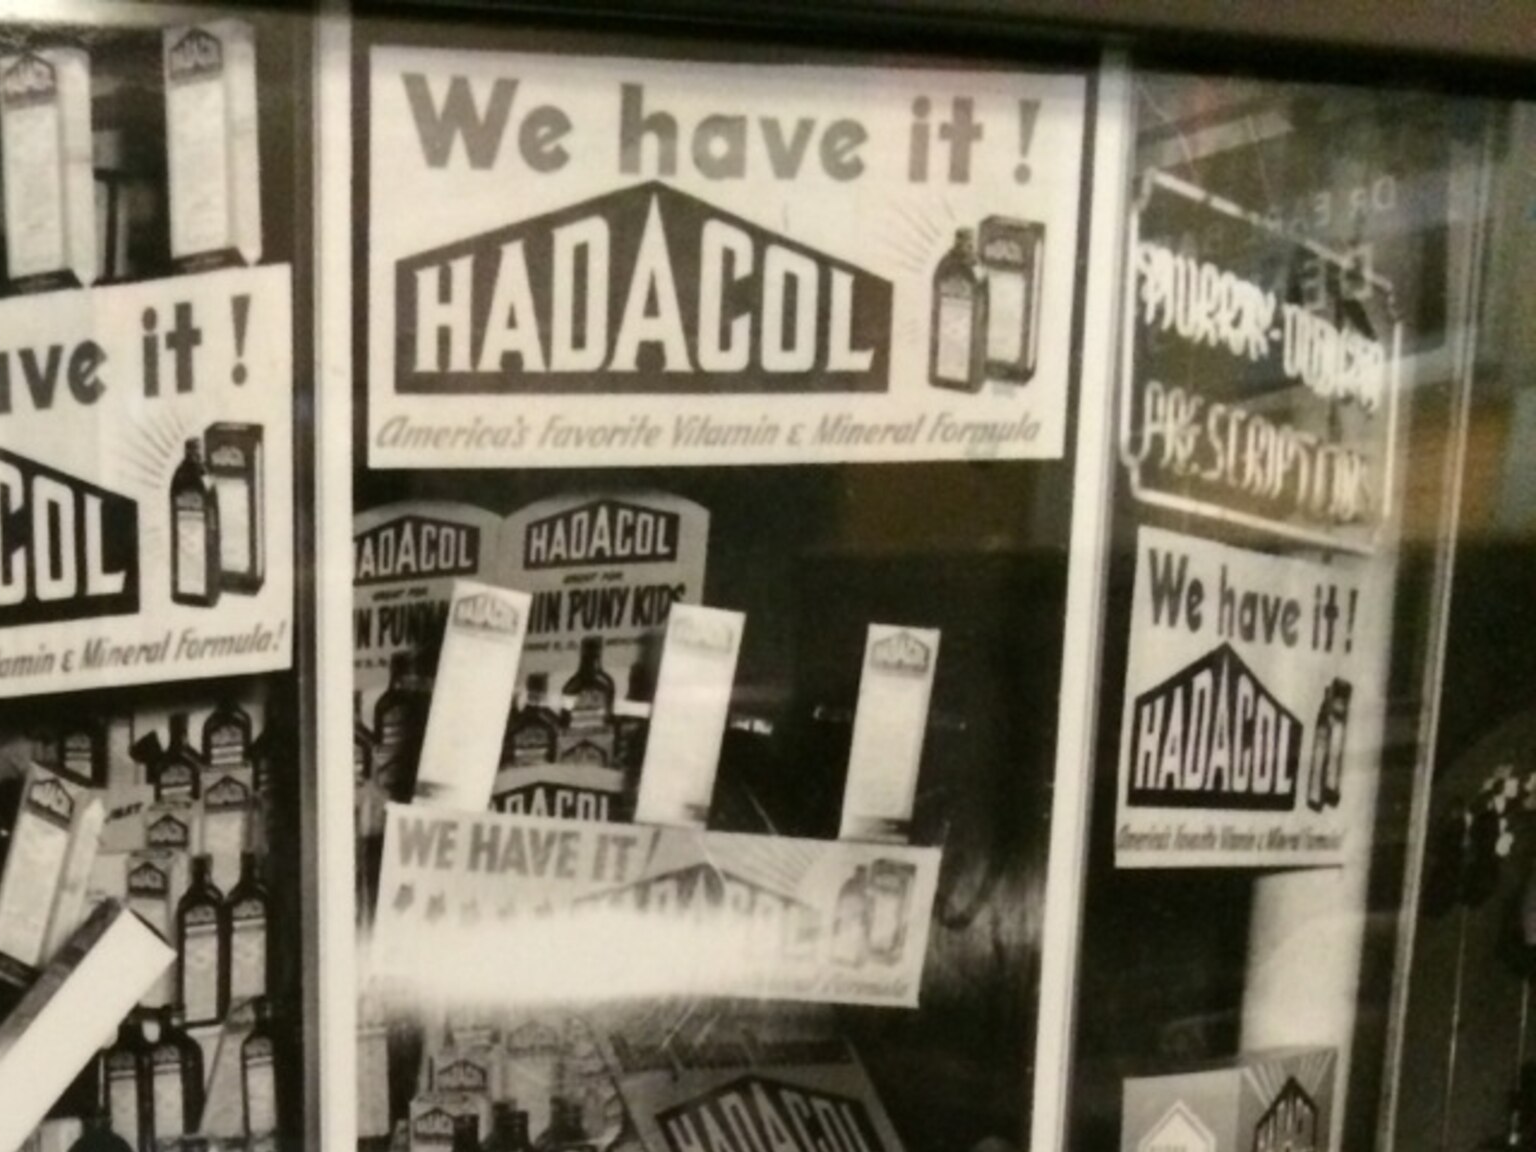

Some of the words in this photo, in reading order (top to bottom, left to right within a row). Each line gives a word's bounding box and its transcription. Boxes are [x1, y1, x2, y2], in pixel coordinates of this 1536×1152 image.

[400, 71, 573, 174] We
[619, 80, 870, 182] have
[412, 191, 875, 373] HADACOL
[538, 413, 661, 450] Favorite
[671, 413, 781, 449] Vitamin
[815, 411, 924, 446] Mineral
[353, 521, 474, 580] ADACOL
[529, 504, 672, 563] HADACOL
[1149, 548, 1205, 634] We
[1217, 562, 1303, 648] have
[80, 629, 168, 670] Mineral
[1133, 650, 1293, 795] HADACOL
[398, 816, 459, 868] WE
[470, 822, 584, 881] HAVE
